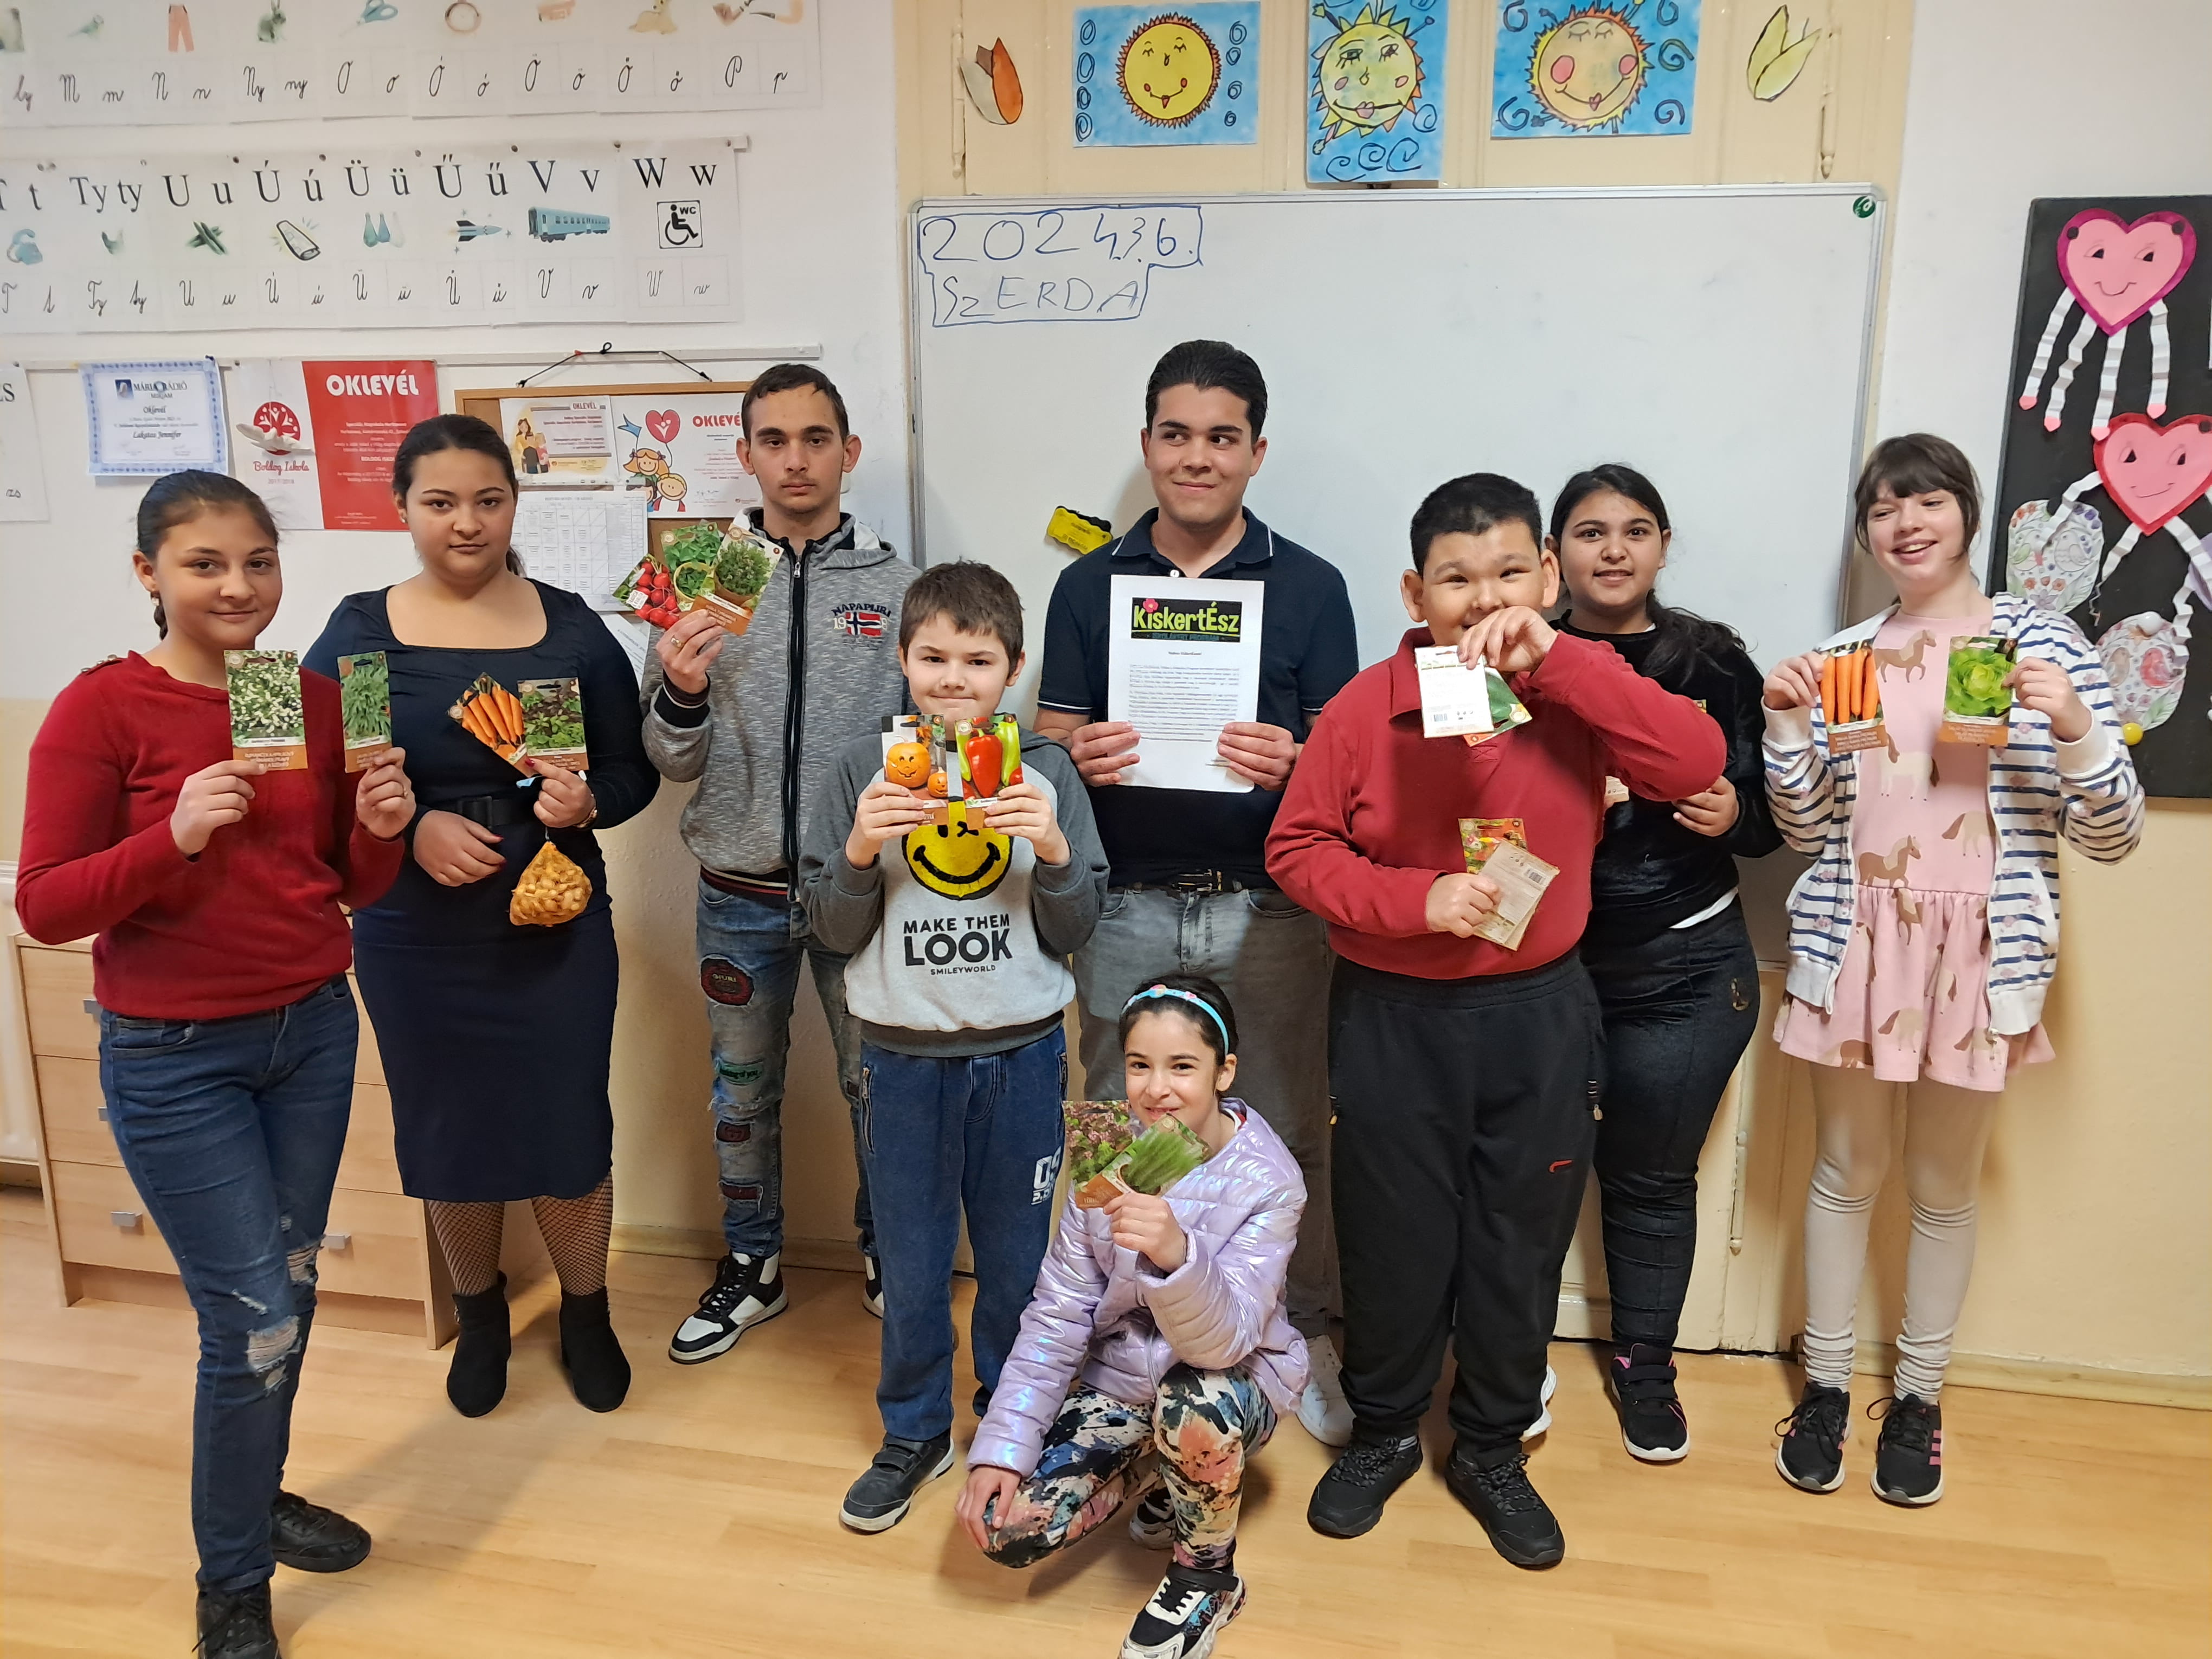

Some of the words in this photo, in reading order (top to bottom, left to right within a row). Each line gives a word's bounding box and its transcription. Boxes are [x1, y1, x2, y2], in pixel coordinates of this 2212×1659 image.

[59, 73, 80, 104] M
[102, 90, 125, 103] m
[151, 71, 169, 101] N
[192, 88, 212, 100] n
[242, 65, 265, 103] Ny
[284, 79, 308, 100] ny
[337, 60, 354, 94] O
[386, 74, 400, 94] o
[429, 55, 446, 98] Ó
[724, 55, 743, 88] P
[773, 71, 788, 94] p
[28, 183, 42, 211] t
[68, 176, 108, 214] Ty
[117, 178, 143, 213] ty
[161, 173, 190, 208] U
[210, 182, 234, 205] u
[252, 159, 280, 203] Ú
[301, 168, 325, 202] ú
[343, 159, 369, 197] Ü
[390, 167, 411, 196] ü
[432, 153, 462, 199] Ű
[485, 162, 510, 197] ű
[526, 159, 557, 195] V
[578, 169, 601, 193] v
[631, 155, 668, 189] W
[688, 164, 718, 187] w
[679, 206, 697, 215] WC
[87, 279, 108, 317] Ty
[178, 280, 195, 307] U
[221, 293, 236, 307] u
[537, 267, 555, 299] V
[582, 281, 600, 300] v
[325, 369, 419, 396] OKLEVÉL
[572, 402, 597, 410] OKLEVÉL
[253, 460, 283, 475] Boldog
[285, 460, 310, 472] Iskola
[831, 603, 892, 618] NAPAPIJRI
[1133, 601, 1240, 632] KiskertÉsz
[833, 617, 847, 629] 19
[903, 918, 957, 934] MAKE
[964, 913, 1009, 930] THEM
[903, 928, 1013, 967] LOOK
[930, 964, 996, 975] SMILEYWORLD
